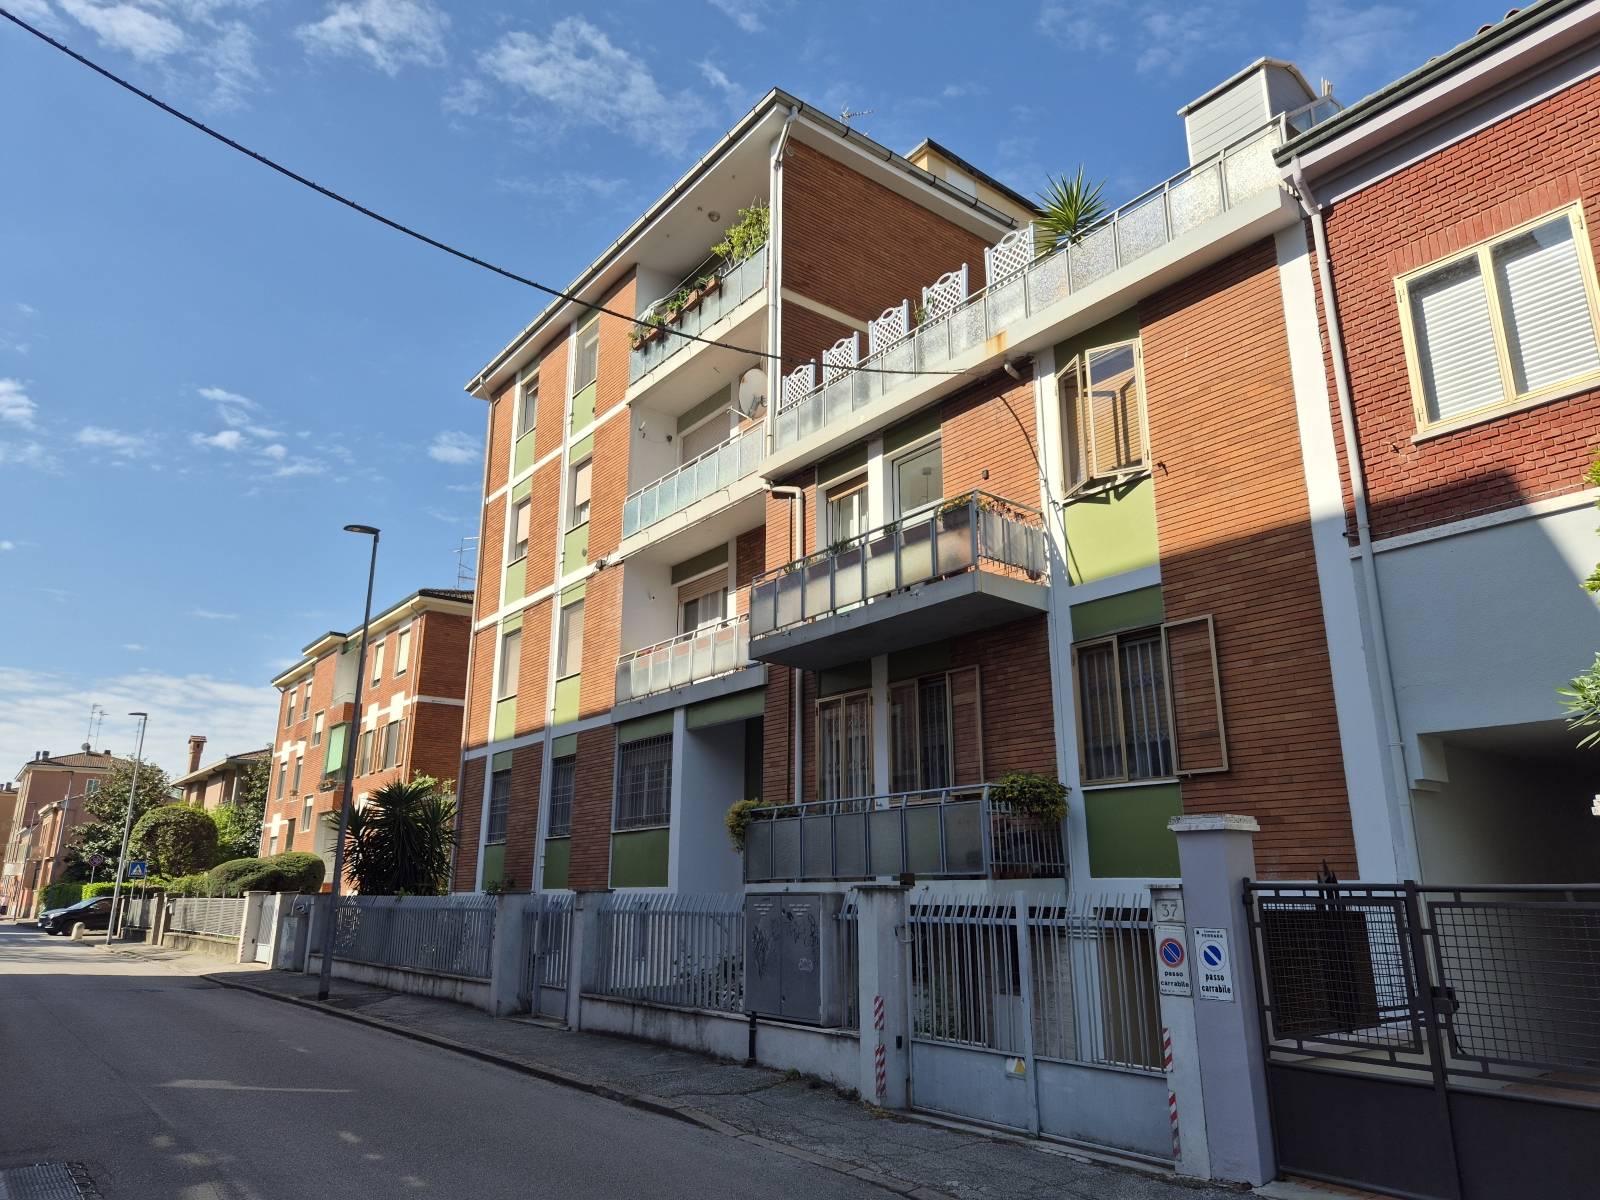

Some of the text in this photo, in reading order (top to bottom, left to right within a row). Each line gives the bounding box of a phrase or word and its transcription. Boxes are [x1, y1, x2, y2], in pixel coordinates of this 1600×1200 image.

[1161, 903, 1178, 918] 37
[1206, 974, 1225, 982] passo
[1161, 980, 1189, 988] carrabile
[1201, 985, 1231, 994] carrabile
